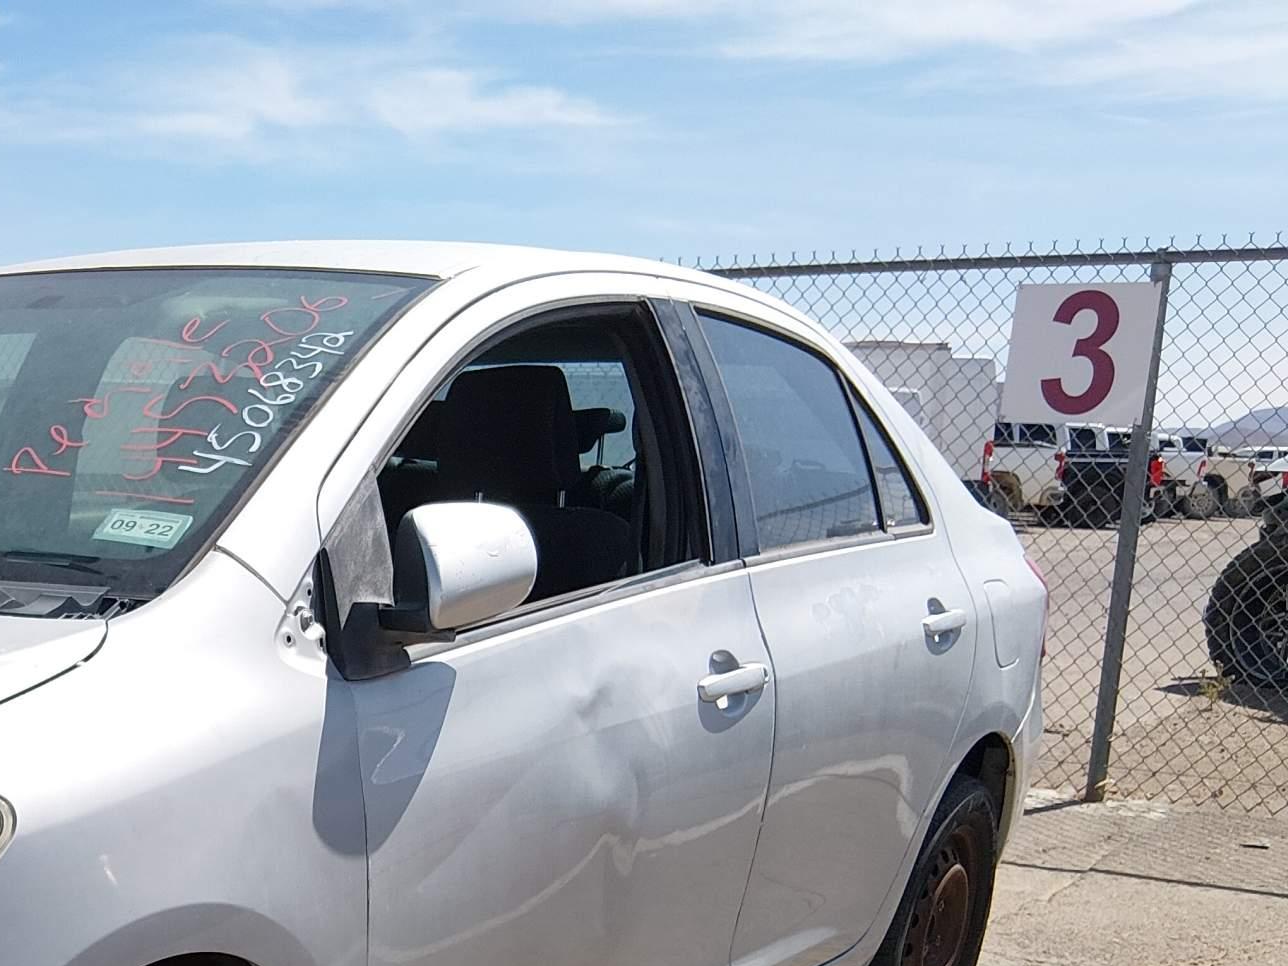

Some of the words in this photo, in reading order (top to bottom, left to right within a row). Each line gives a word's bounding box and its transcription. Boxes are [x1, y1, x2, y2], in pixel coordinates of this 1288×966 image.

[177, 331, 354, 474] 45068342
[1040, 289, 1120, 415] 3
[110, 519, 137, 532] 09
[144, 523, 174, 537] 22
